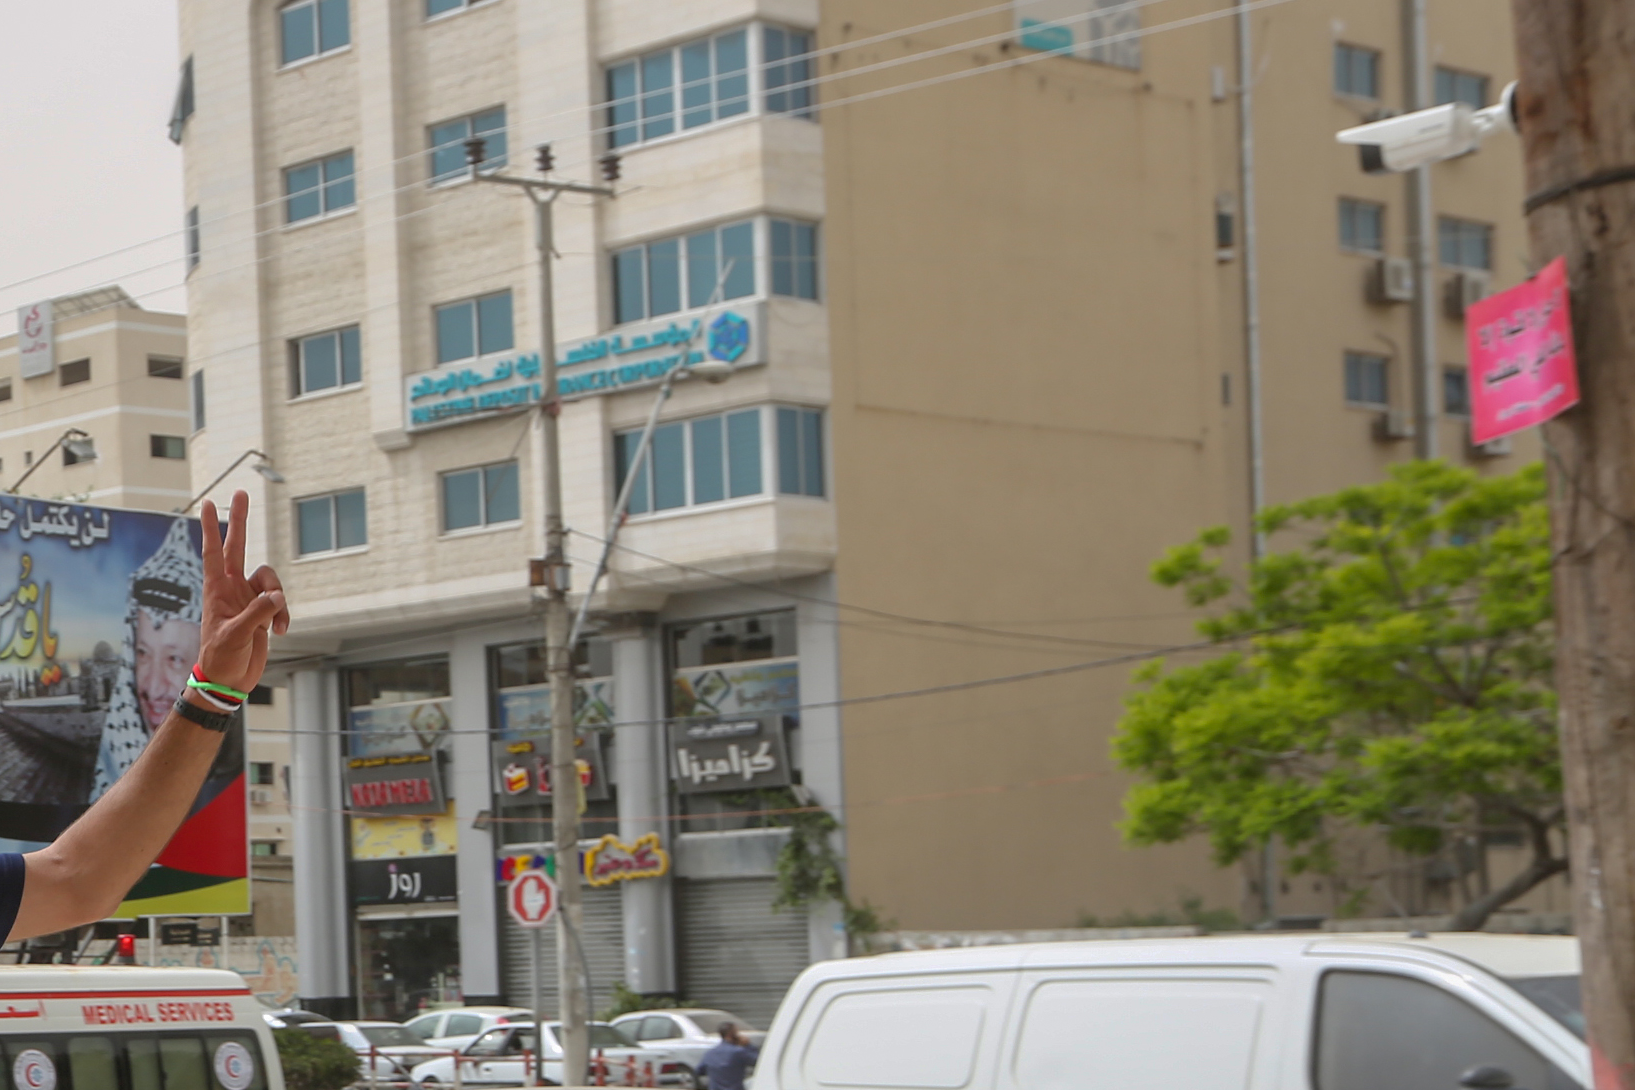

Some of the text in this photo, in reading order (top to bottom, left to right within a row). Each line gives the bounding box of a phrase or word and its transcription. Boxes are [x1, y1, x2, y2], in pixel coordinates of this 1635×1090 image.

[19, 504, 79, 547] يكتمل
[81, 511, 110, 546] لن
[387, 863, 422, 900] روز
[81, 1002, 235, 1025] MEDICAL SERVICES
